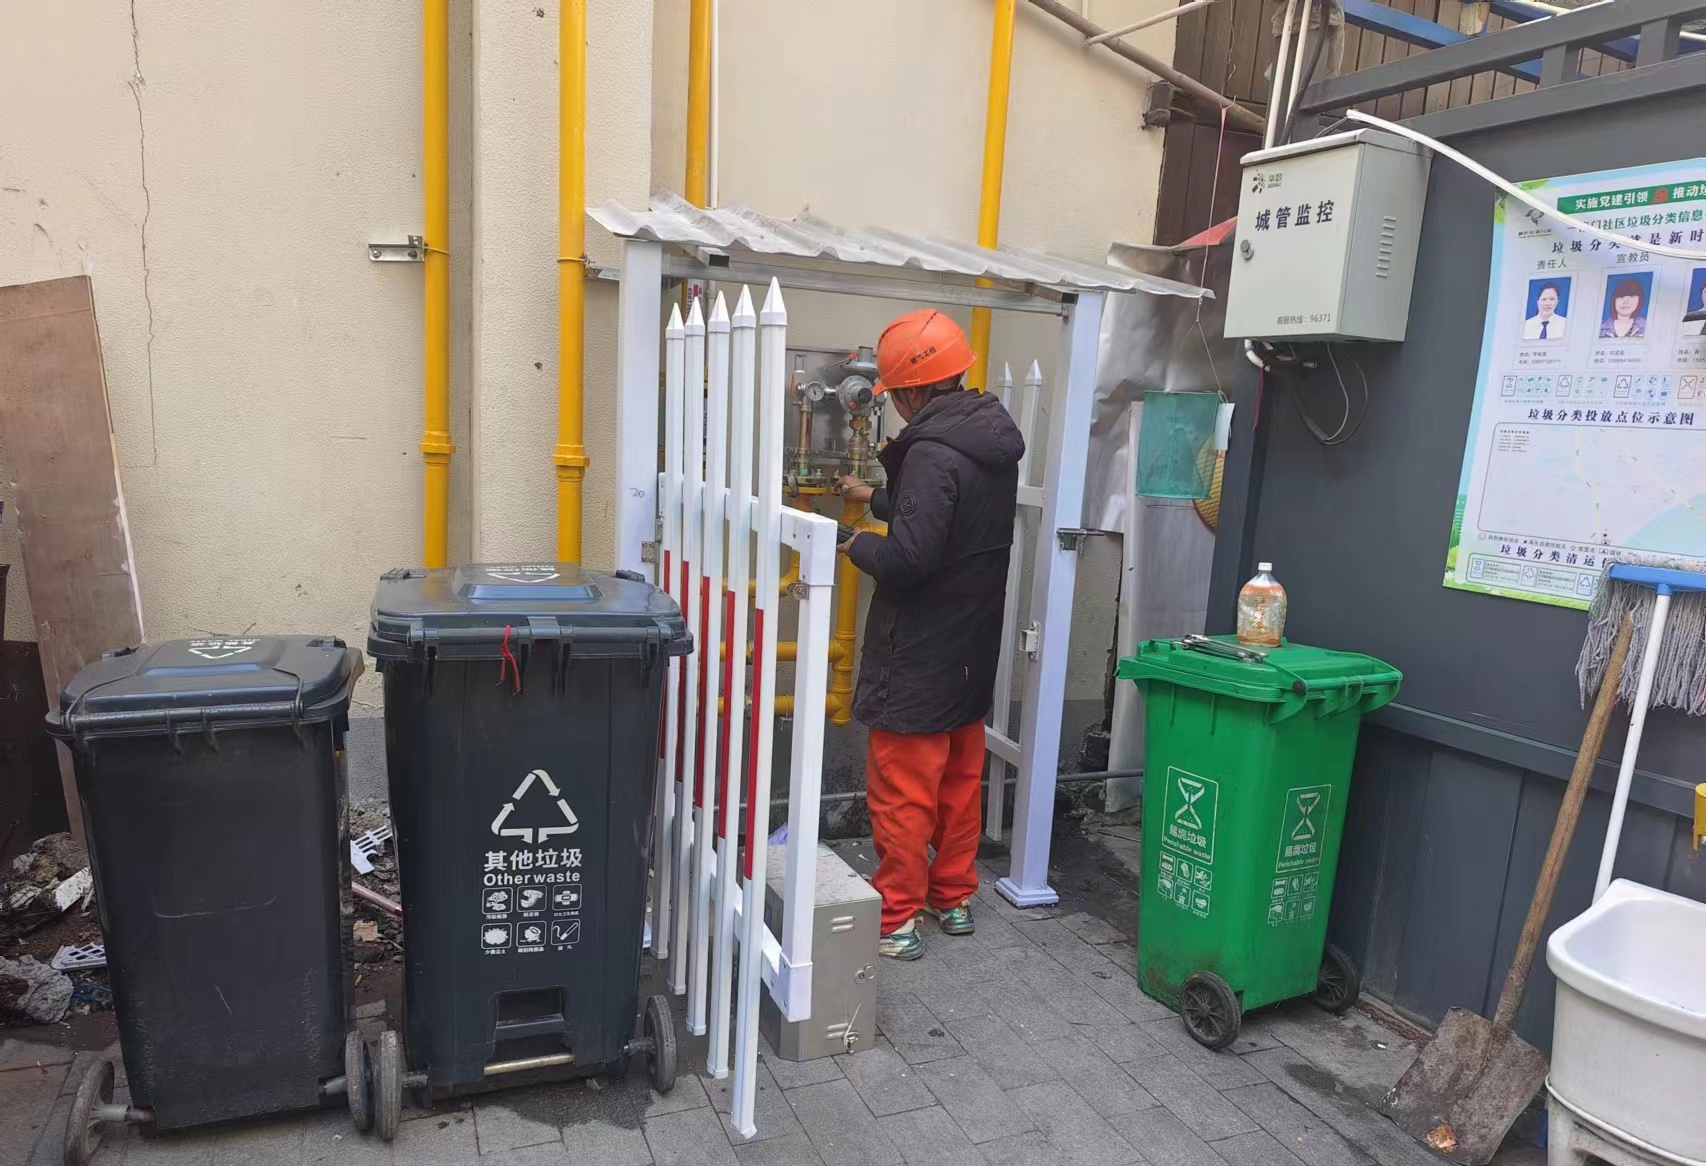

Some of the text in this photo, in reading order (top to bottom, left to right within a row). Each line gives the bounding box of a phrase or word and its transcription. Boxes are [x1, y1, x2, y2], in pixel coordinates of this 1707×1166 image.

[1575, 190, 1649, 210] 实施党建引领
[1255, 200, 1334, 231] 城管监控
[1537, 259, 1568, 270] 责任人
[1616, 252, 1650, 264] 宣教员
[1528, 408, 1694, 425] 垃圾分类投放点位示意图
[1500, 544, 1607, 568] 垃圾分类清运
[484, 848, 582, 871] 其他垃圾
[1193, 849, 1211, 860] waste
[483, 870, 580, 886] Other waste
